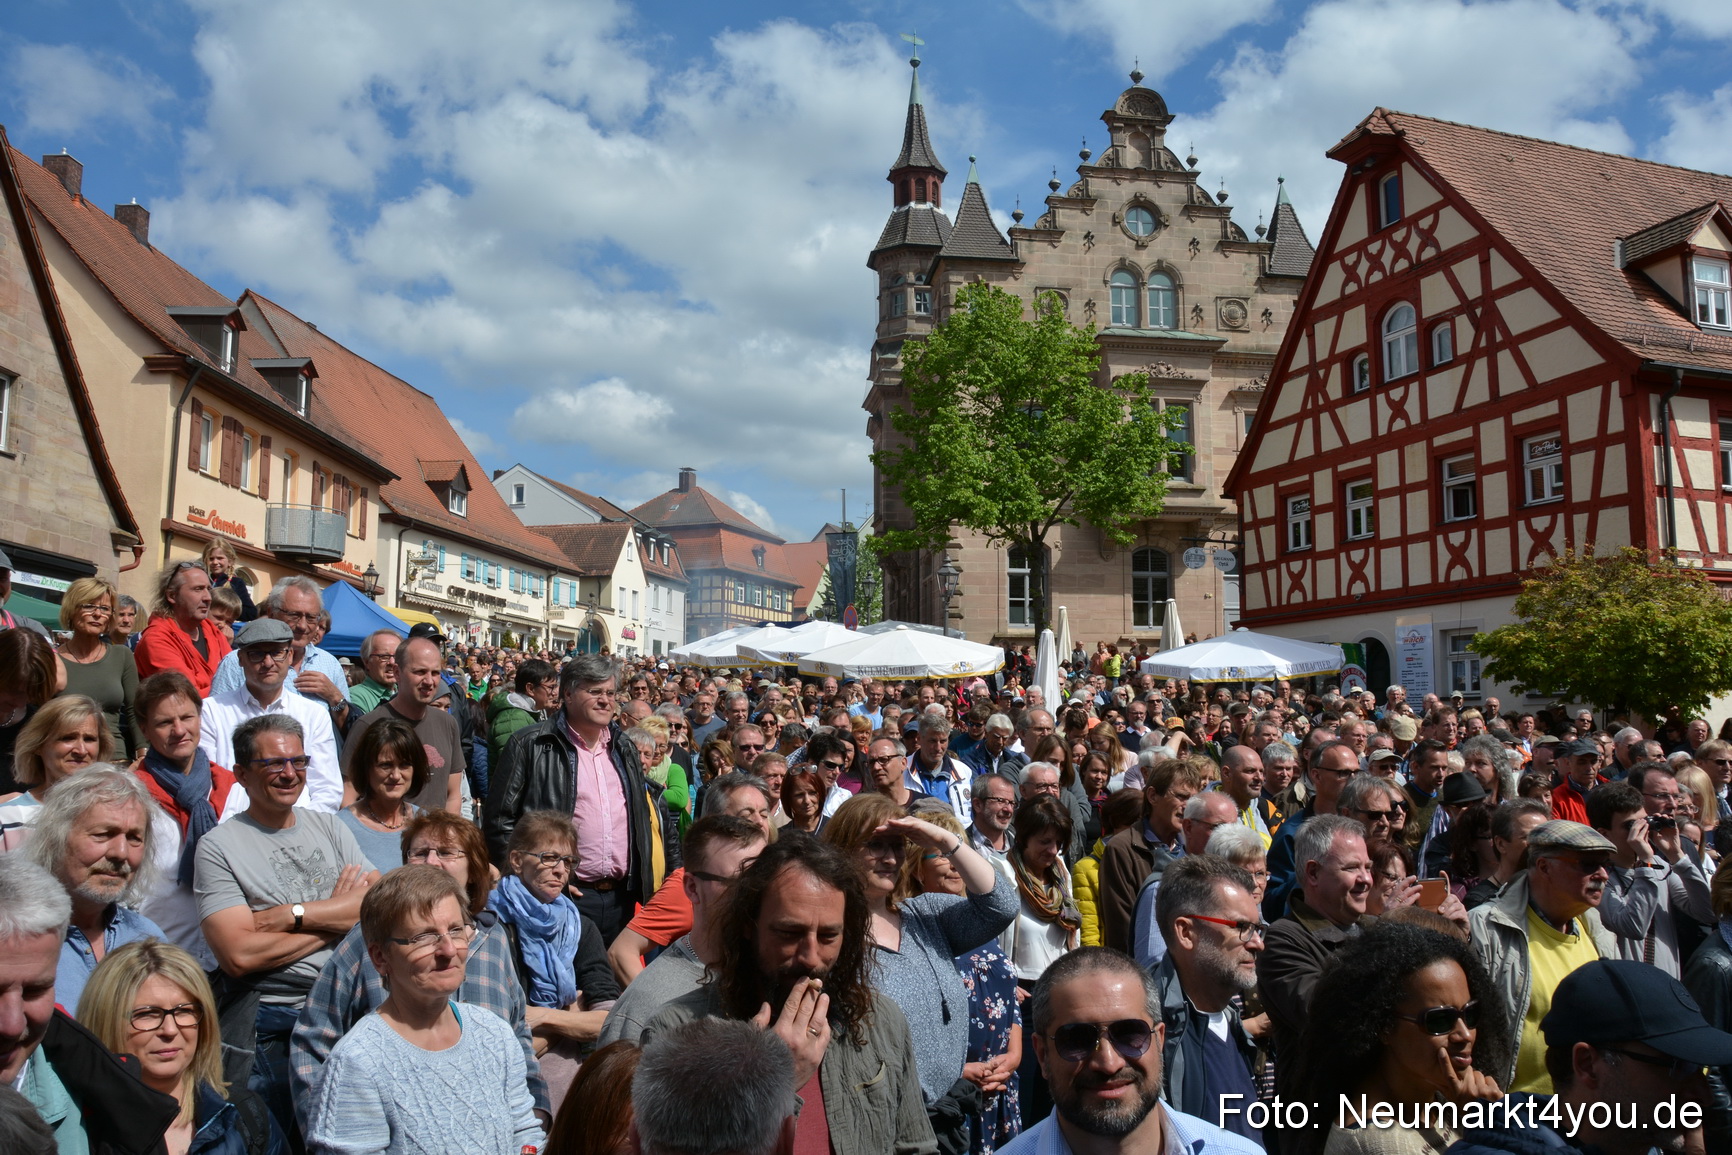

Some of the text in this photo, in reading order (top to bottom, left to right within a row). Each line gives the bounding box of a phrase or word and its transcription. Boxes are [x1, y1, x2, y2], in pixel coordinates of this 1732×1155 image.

[187, 509, 246, 539] Schmidt
[857, 665, 916, 676] KULMBACHER
[1285, 660, 1332, 675] KULMBACHER
